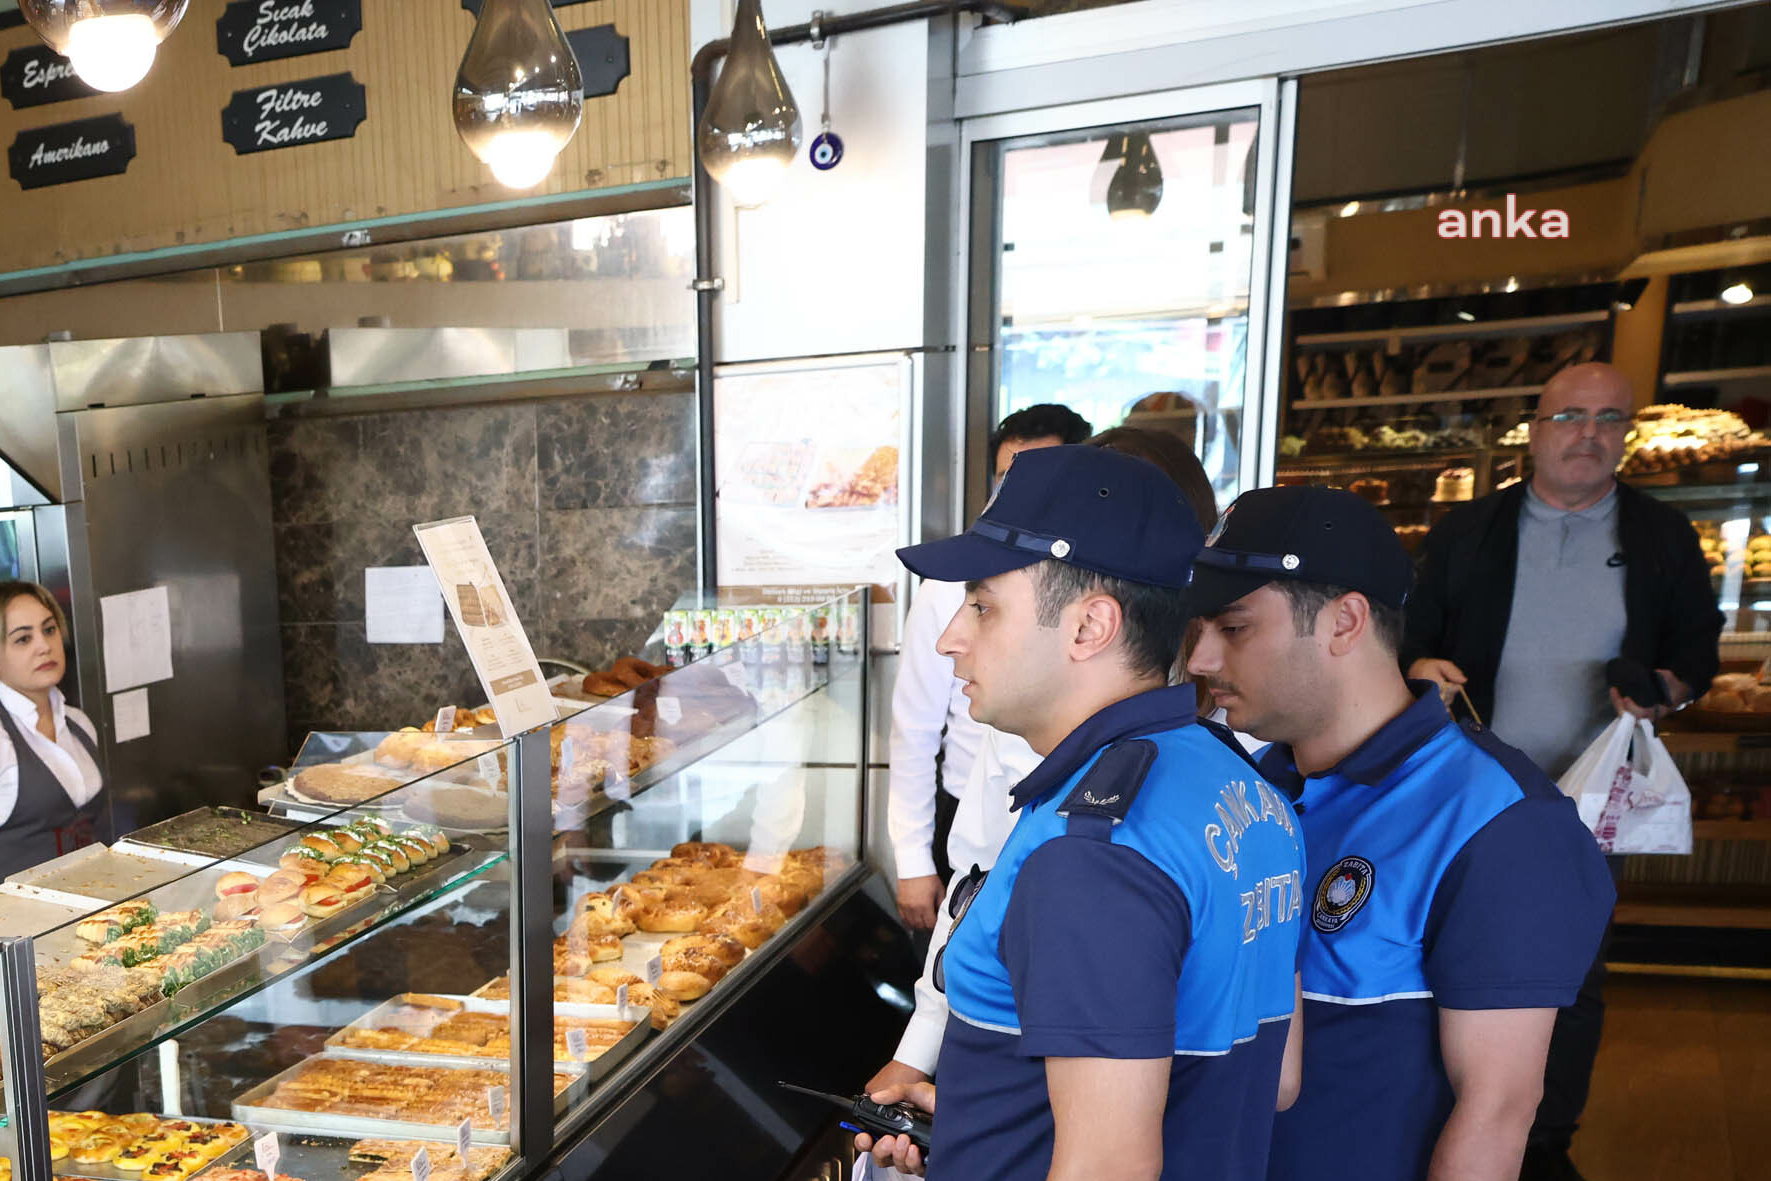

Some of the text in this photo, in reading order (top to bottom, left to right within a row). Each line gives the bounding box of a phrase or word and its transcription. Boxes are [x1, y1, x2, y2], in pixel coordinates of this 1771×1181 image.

[256, 0, 314, 24] Sıcak
[243, 21, 329, 57] Çikolata
[256, 89, 322, 119] Filtre
[254, 118, 328, 146] Kahve
[29, 136, 110, 169] Amerikano
